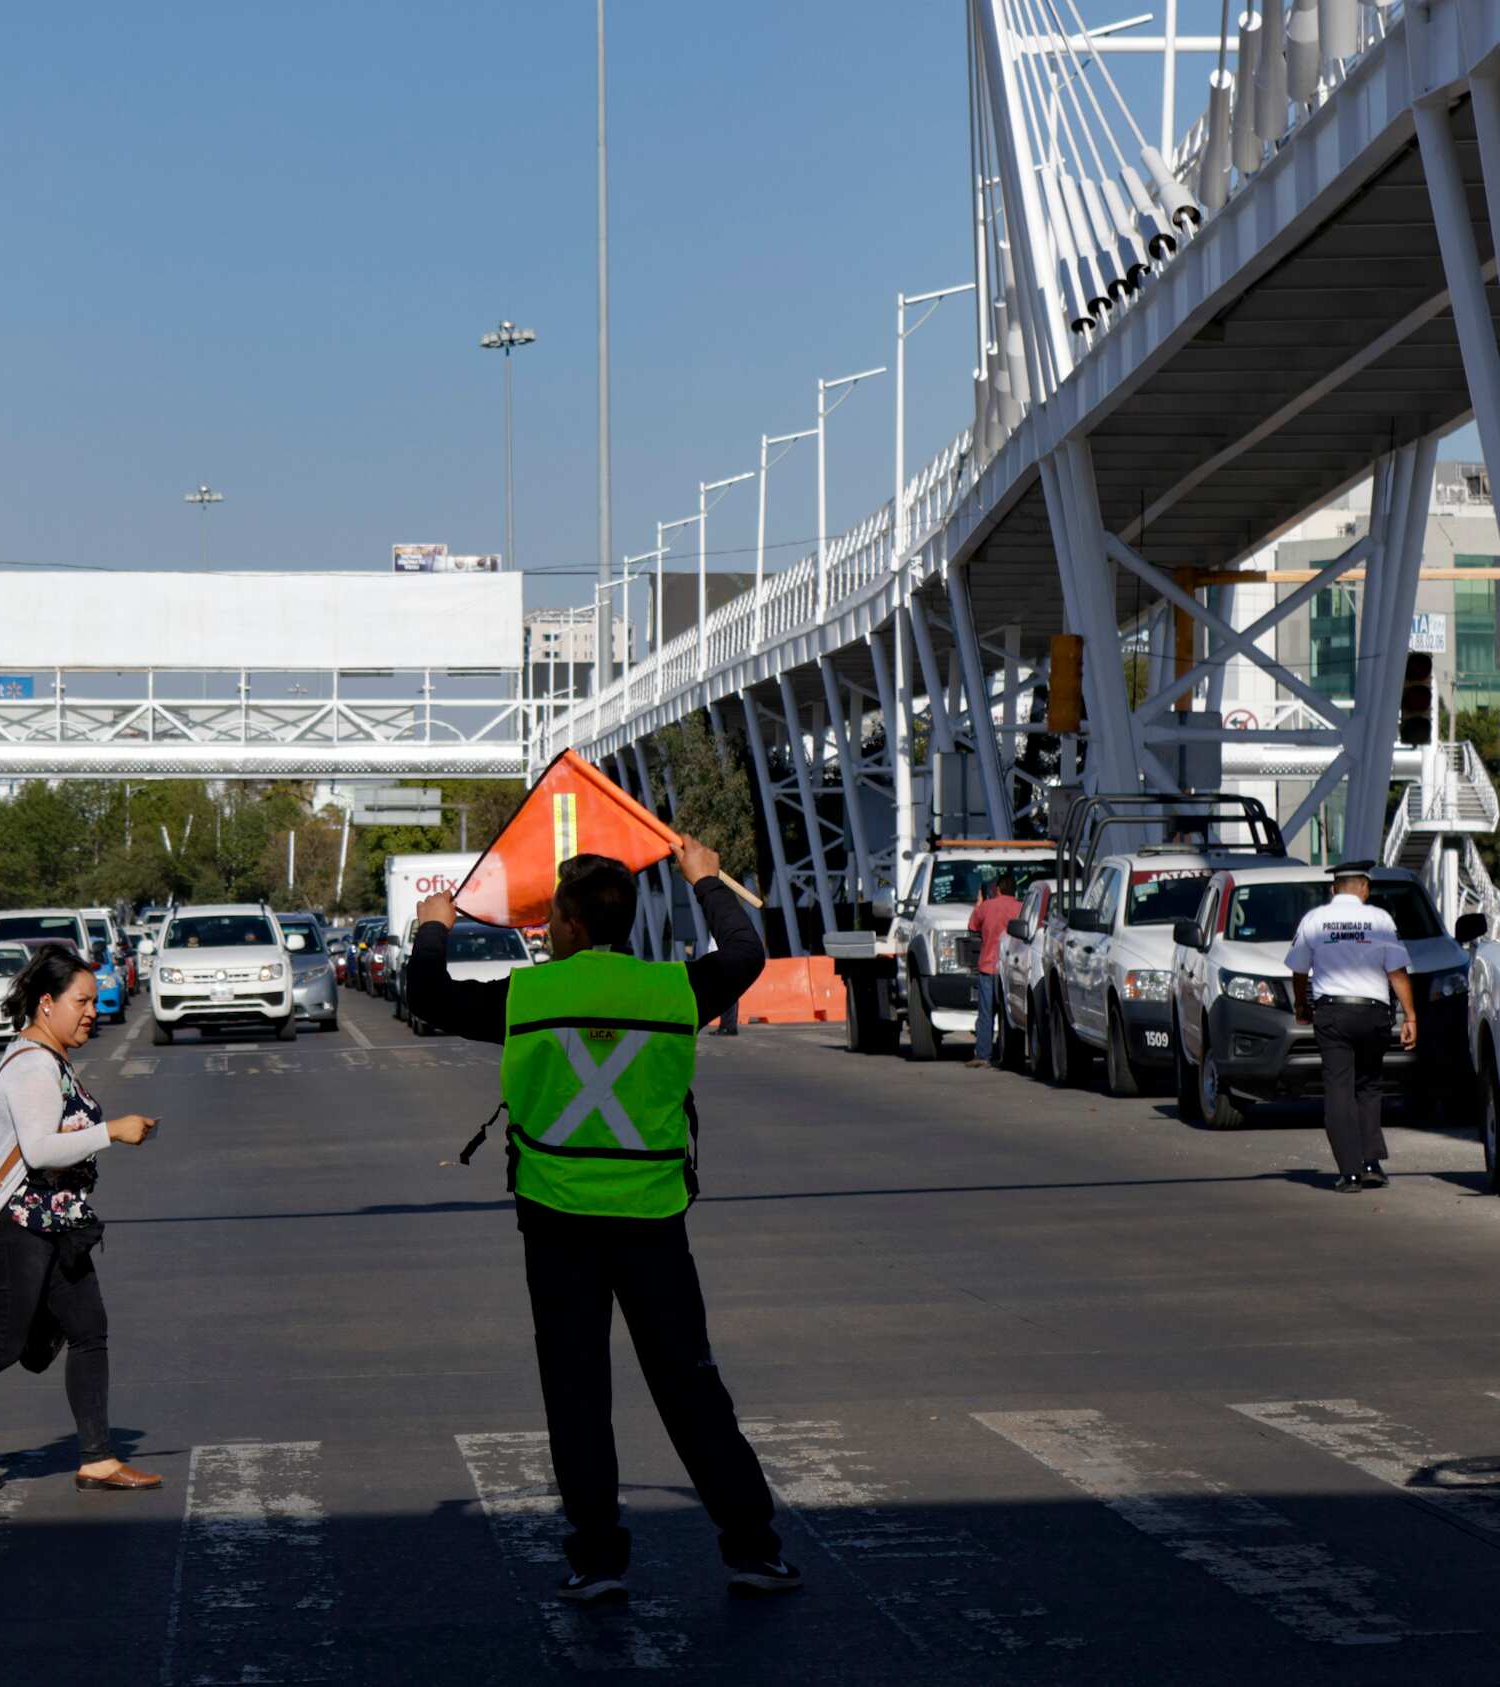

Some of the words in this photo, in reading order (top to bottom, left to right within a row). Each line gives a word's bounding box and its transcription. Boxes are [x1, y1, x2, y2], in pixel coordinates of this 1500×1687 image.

[1363, 922, 1372, 931] DE
[1330, 931, 1365, 941] CAMINOS
[1145, 1030, 1169, 1048] 1509
